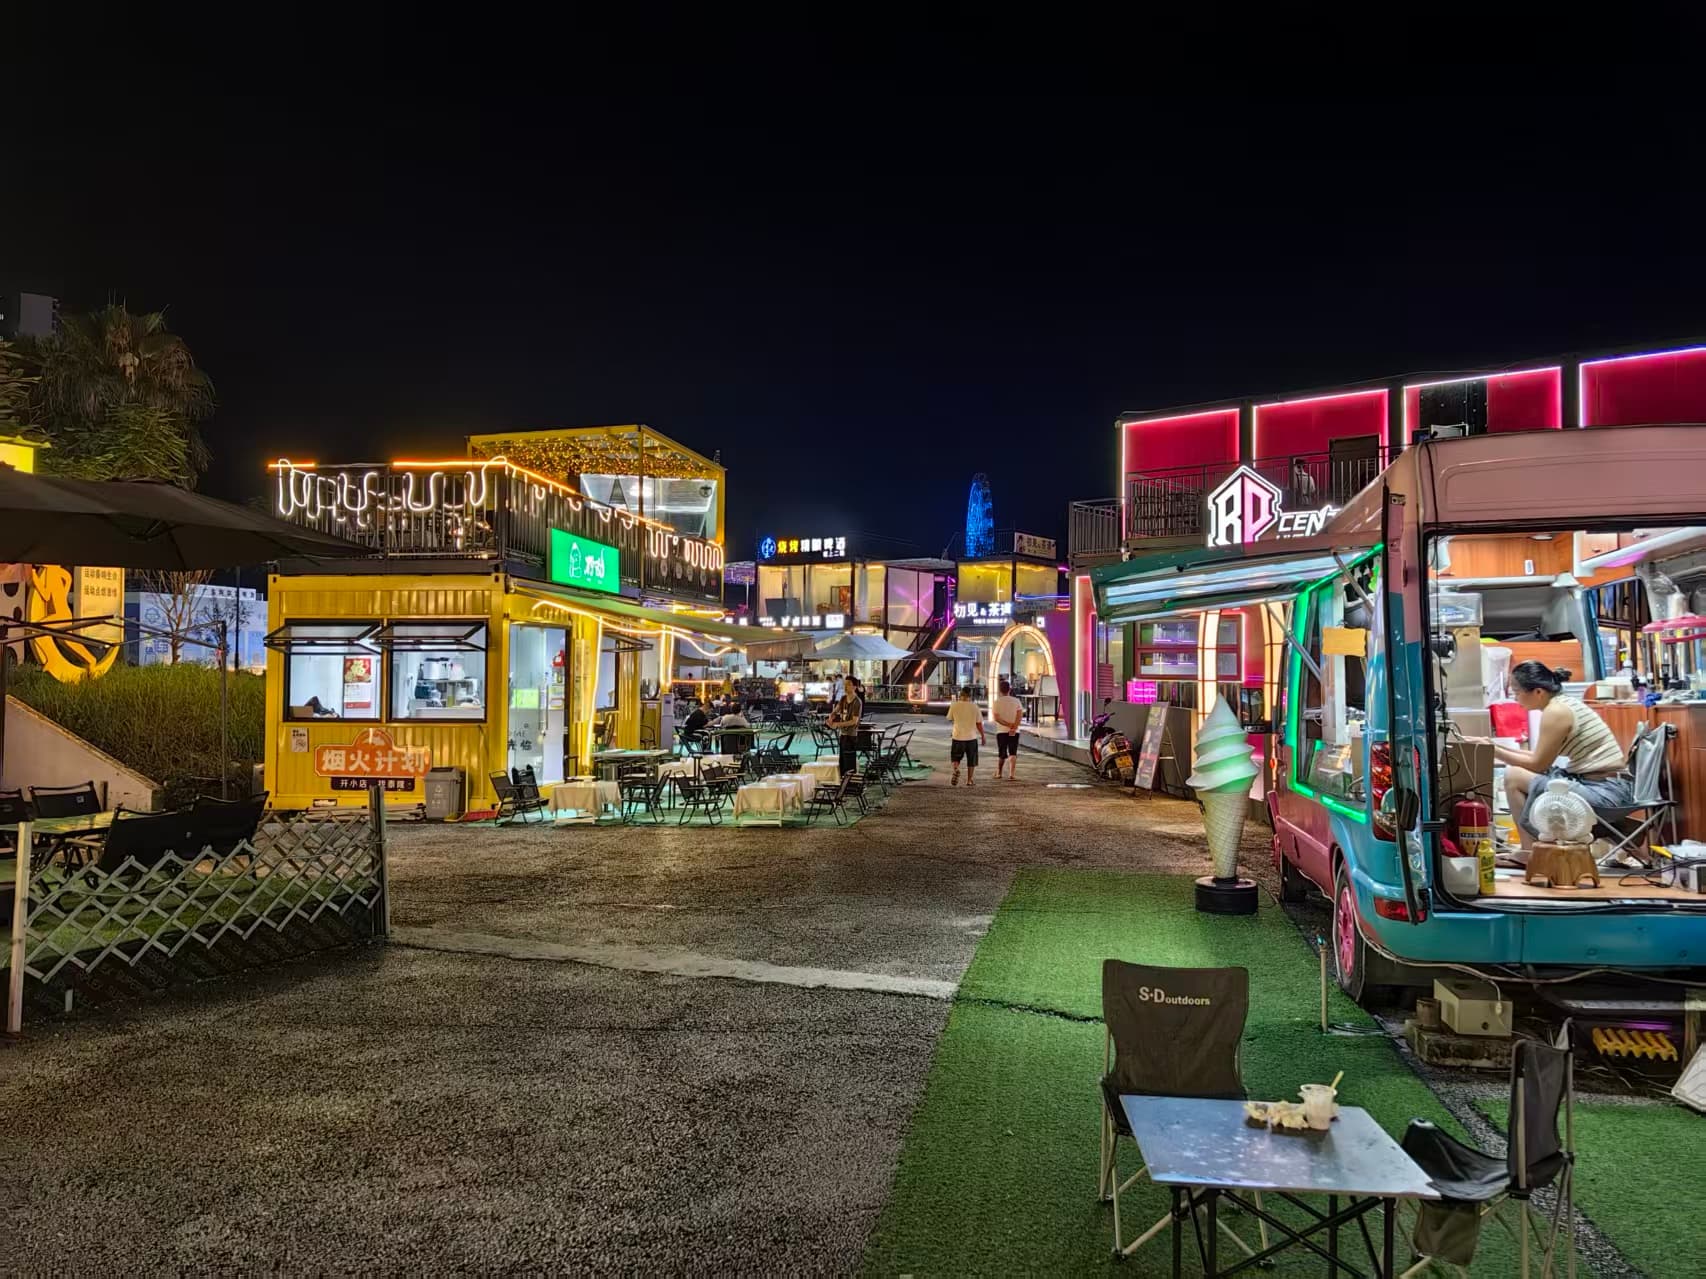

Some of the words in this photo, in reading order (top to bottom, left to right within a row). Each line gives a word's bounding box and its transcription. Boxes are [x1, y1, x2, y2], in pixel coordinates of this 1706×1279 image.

[321, 749, 426, 773] 烟火计划
[340, 779, 368, 789] 开小店
